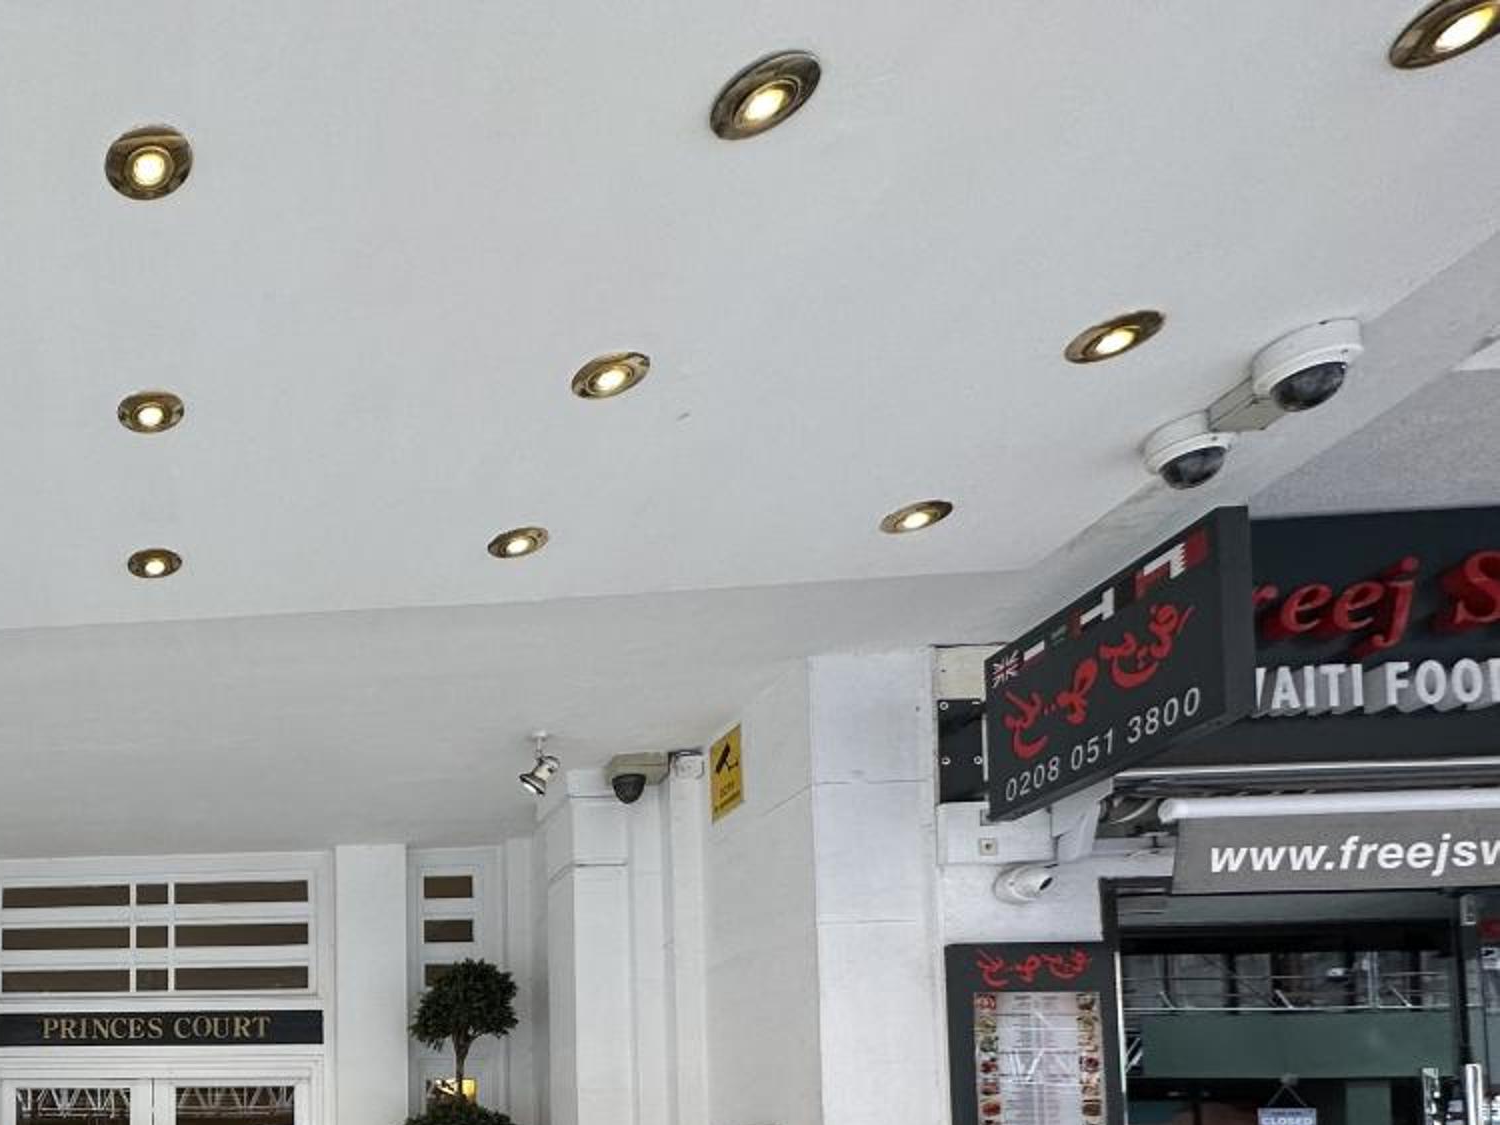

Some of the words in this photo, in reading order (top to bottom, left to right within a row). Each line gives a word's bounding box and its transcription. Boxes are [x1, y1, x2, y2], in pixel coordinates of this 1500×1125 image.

[1252, 556, 1418, 648] reej
[1455, 550, 1500, 625] S
[1255, 663, 1365, 711] AITI
[1005, 756, 1060, 801] 0208
[1071, 728, 1113, 771] 051
[1127, 687, 1200, 745] 3800
[1211, 833, 1500, 877] www.freejsw
[41, 1016, 163, 1040] PRINCES
[173, 1015, 271, 1039] COURT
